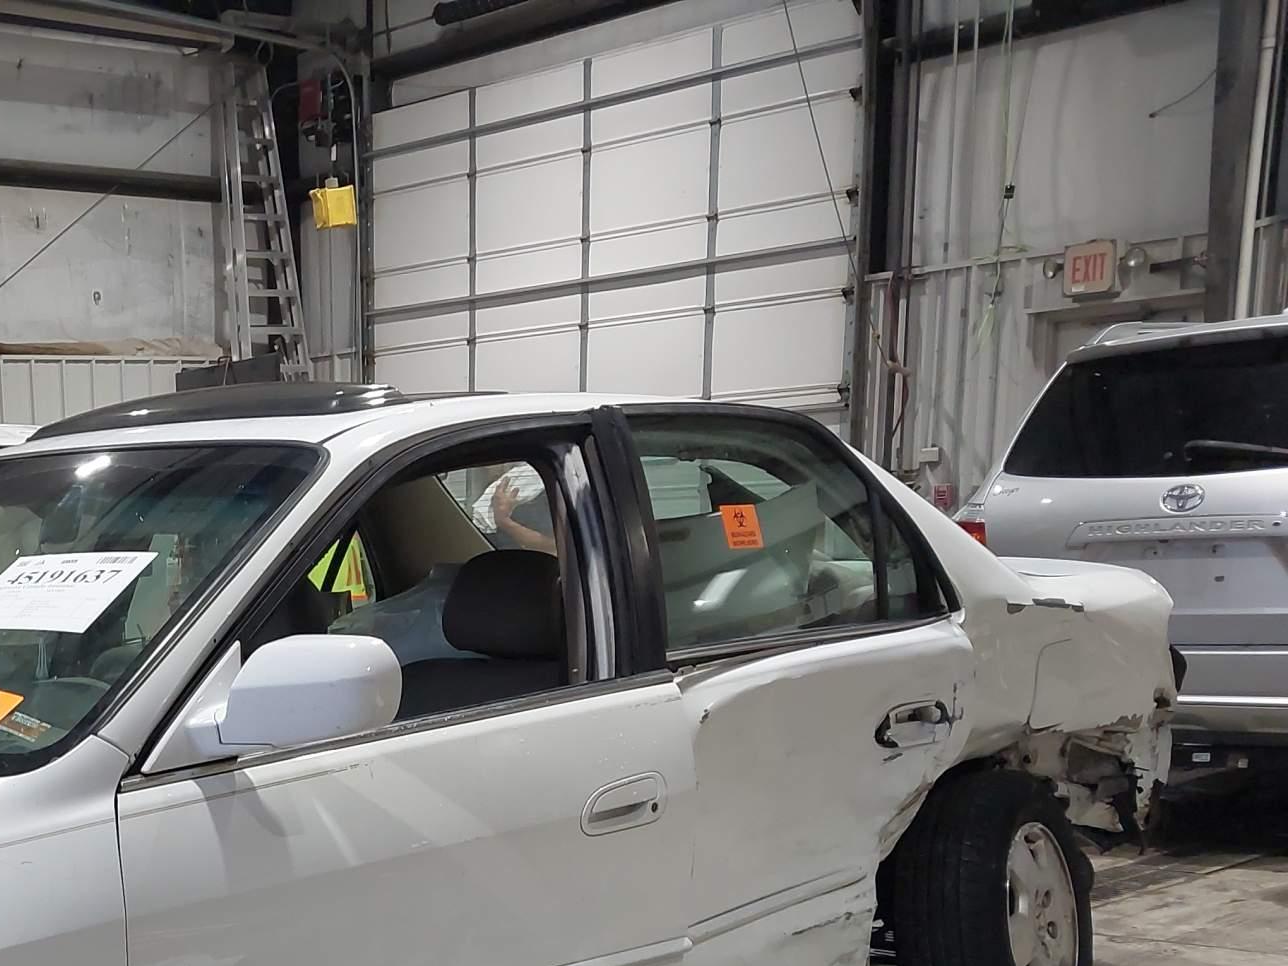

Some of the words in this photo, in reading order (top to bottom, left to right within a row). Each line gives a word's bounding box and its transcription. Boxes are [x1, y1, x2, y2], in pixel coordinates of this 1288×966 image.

[1072, 253, 1107, 284] EXIT
[1088, 519, 1266, 537] HIGHLANDER
[8, 569, 123, 585] 45191637
